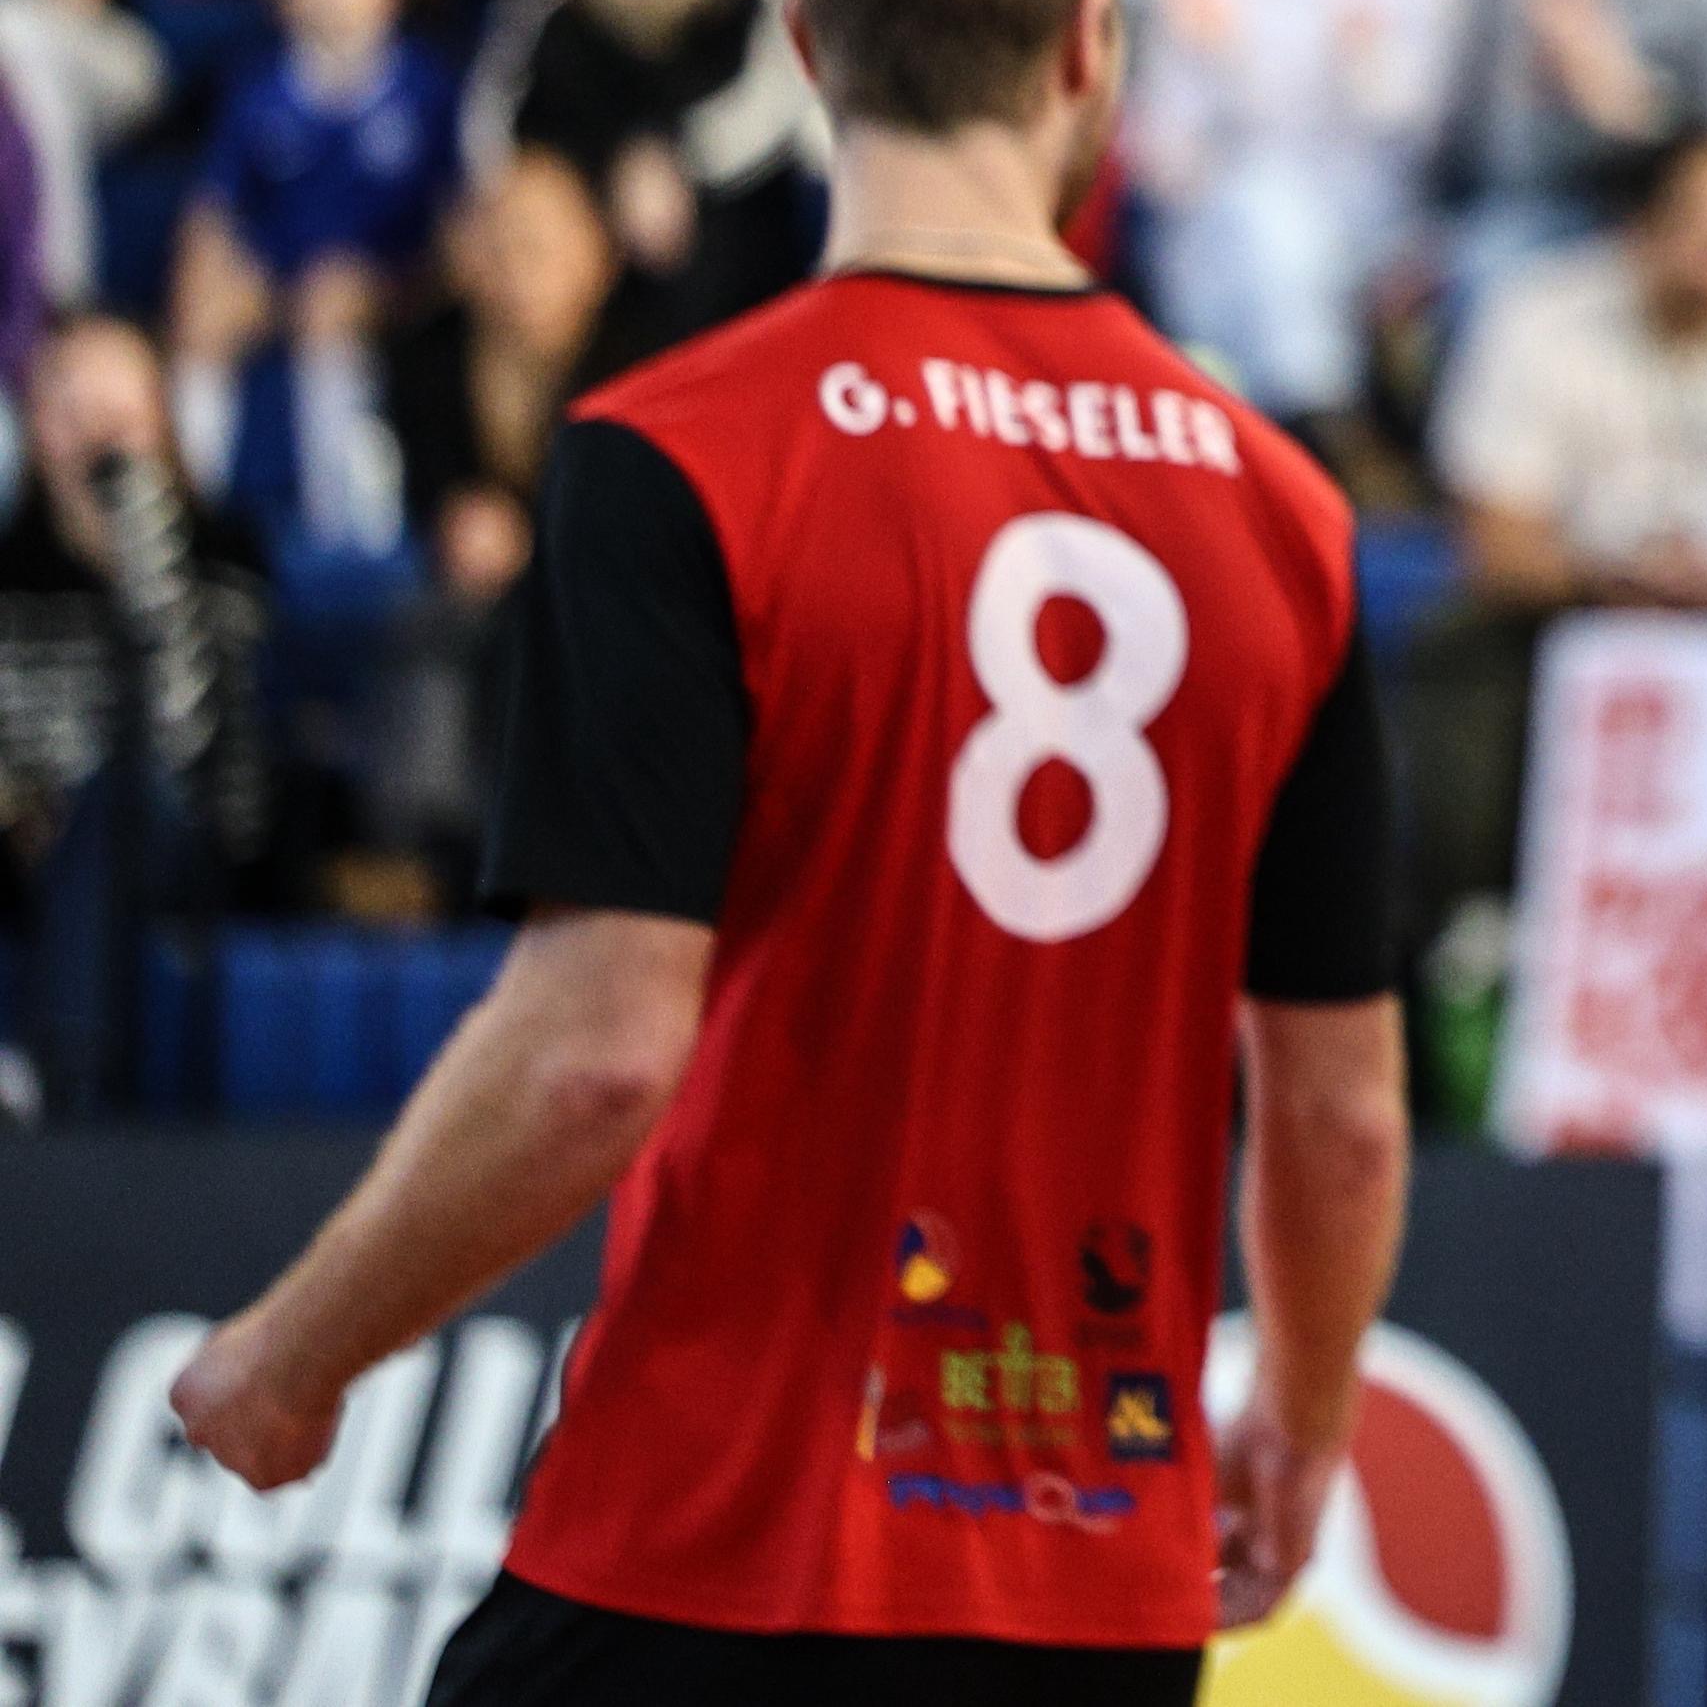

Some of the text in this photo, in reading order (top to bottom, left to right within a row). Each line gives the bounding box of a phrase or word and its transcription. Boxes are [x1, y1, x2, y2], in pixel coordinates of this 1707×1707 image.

[817, 356, 1243, 478] G. FIESELER
[946, 509, 1189, 945] 8
